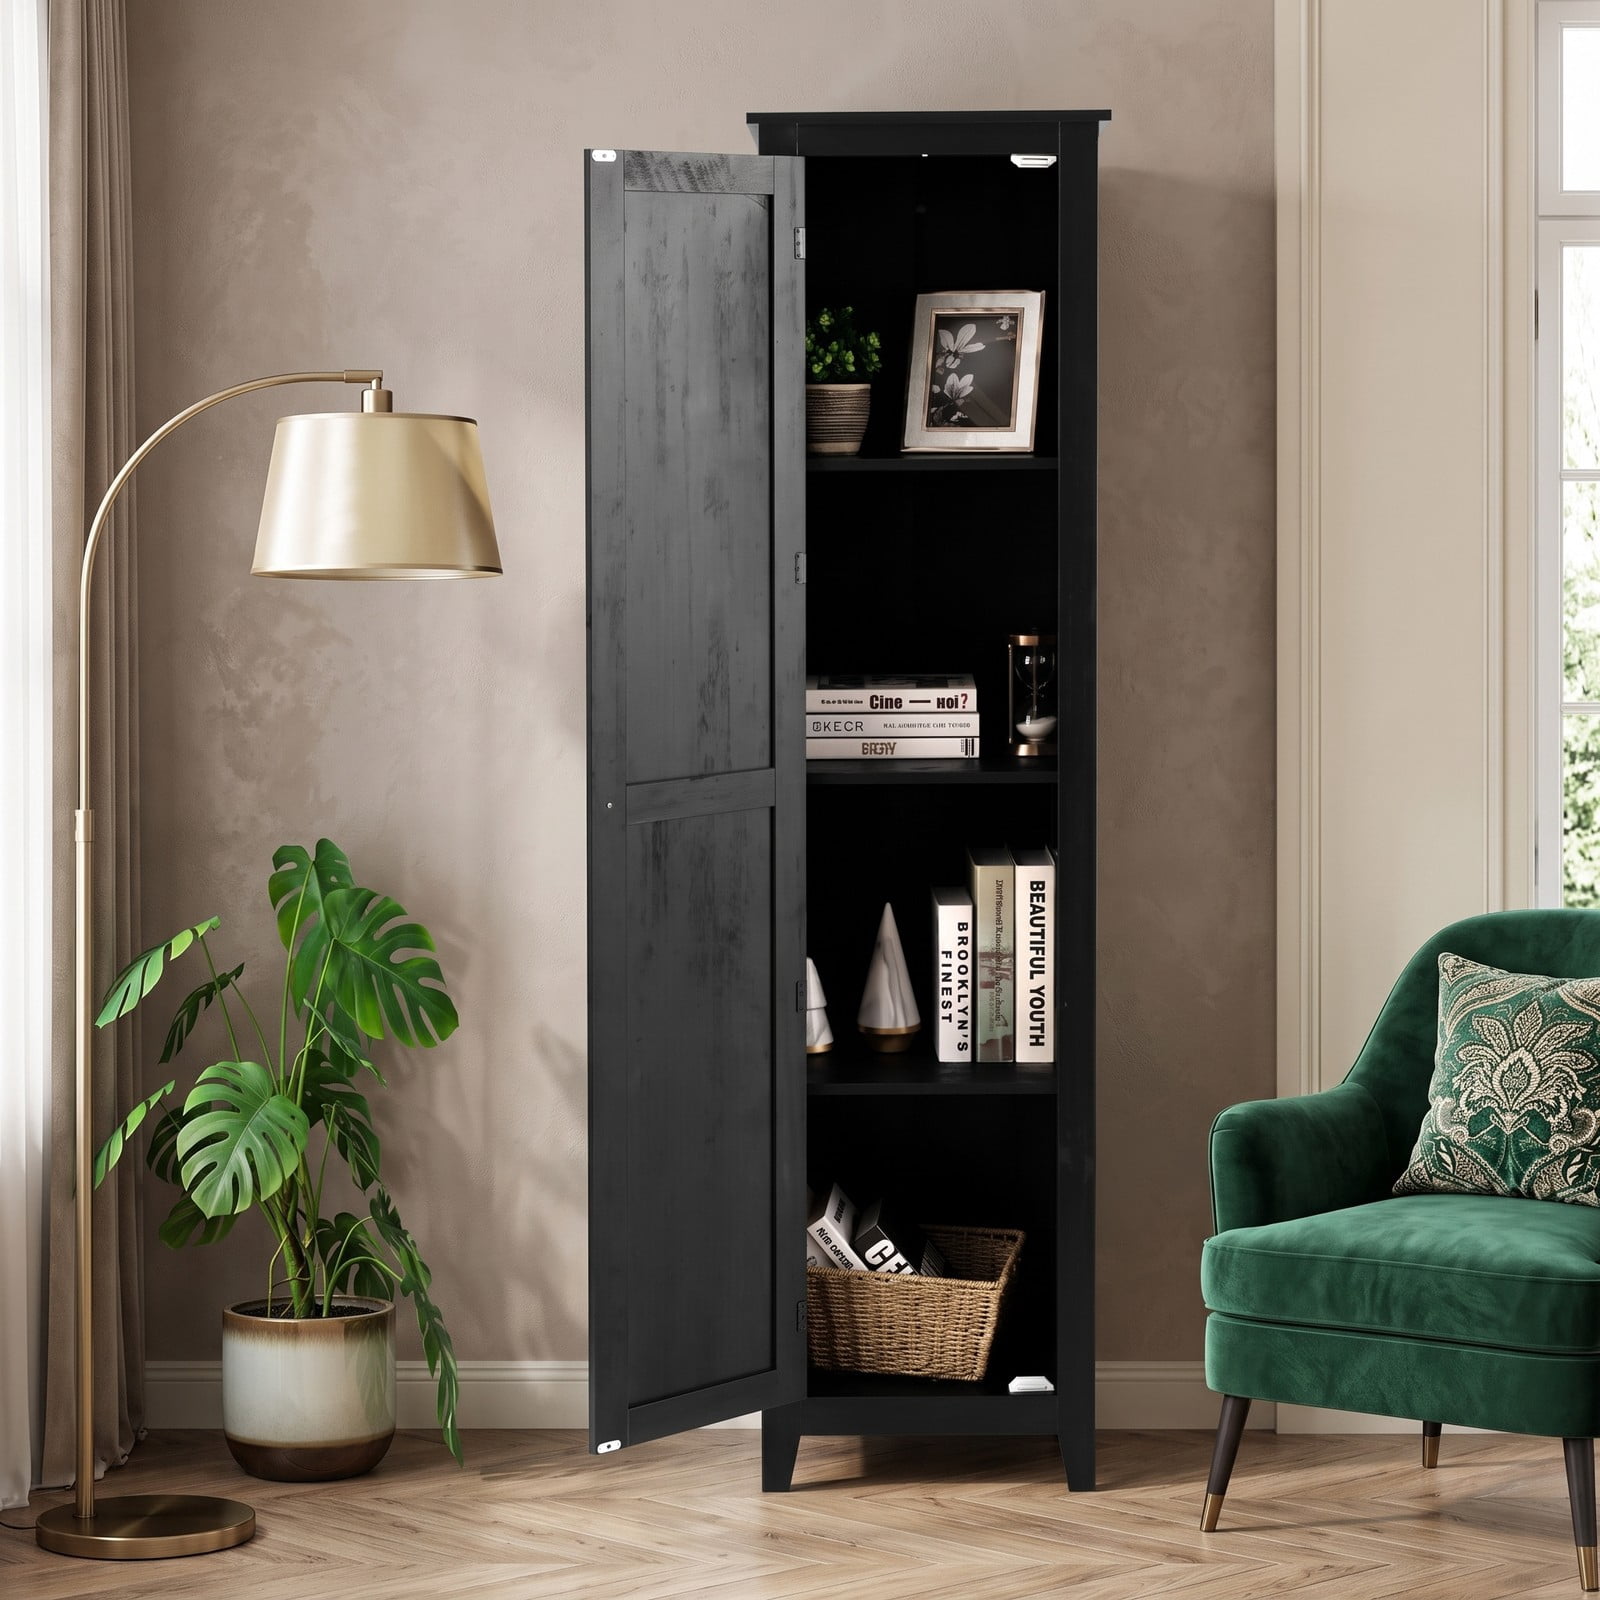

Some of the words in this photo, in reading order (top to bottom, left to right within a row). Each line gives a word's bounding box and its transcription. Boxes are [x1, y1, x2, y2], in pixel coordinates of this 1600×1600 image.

[869, 694, 903, 710] Cine
[1029, 880, 1046, 980] BEAUTIFUL
[941, 950, 953, 1023] FINEST
[957, 922, 969, 1052] BROOKLYN'S
[1029, 985, 1046, 1046] YOUTH
